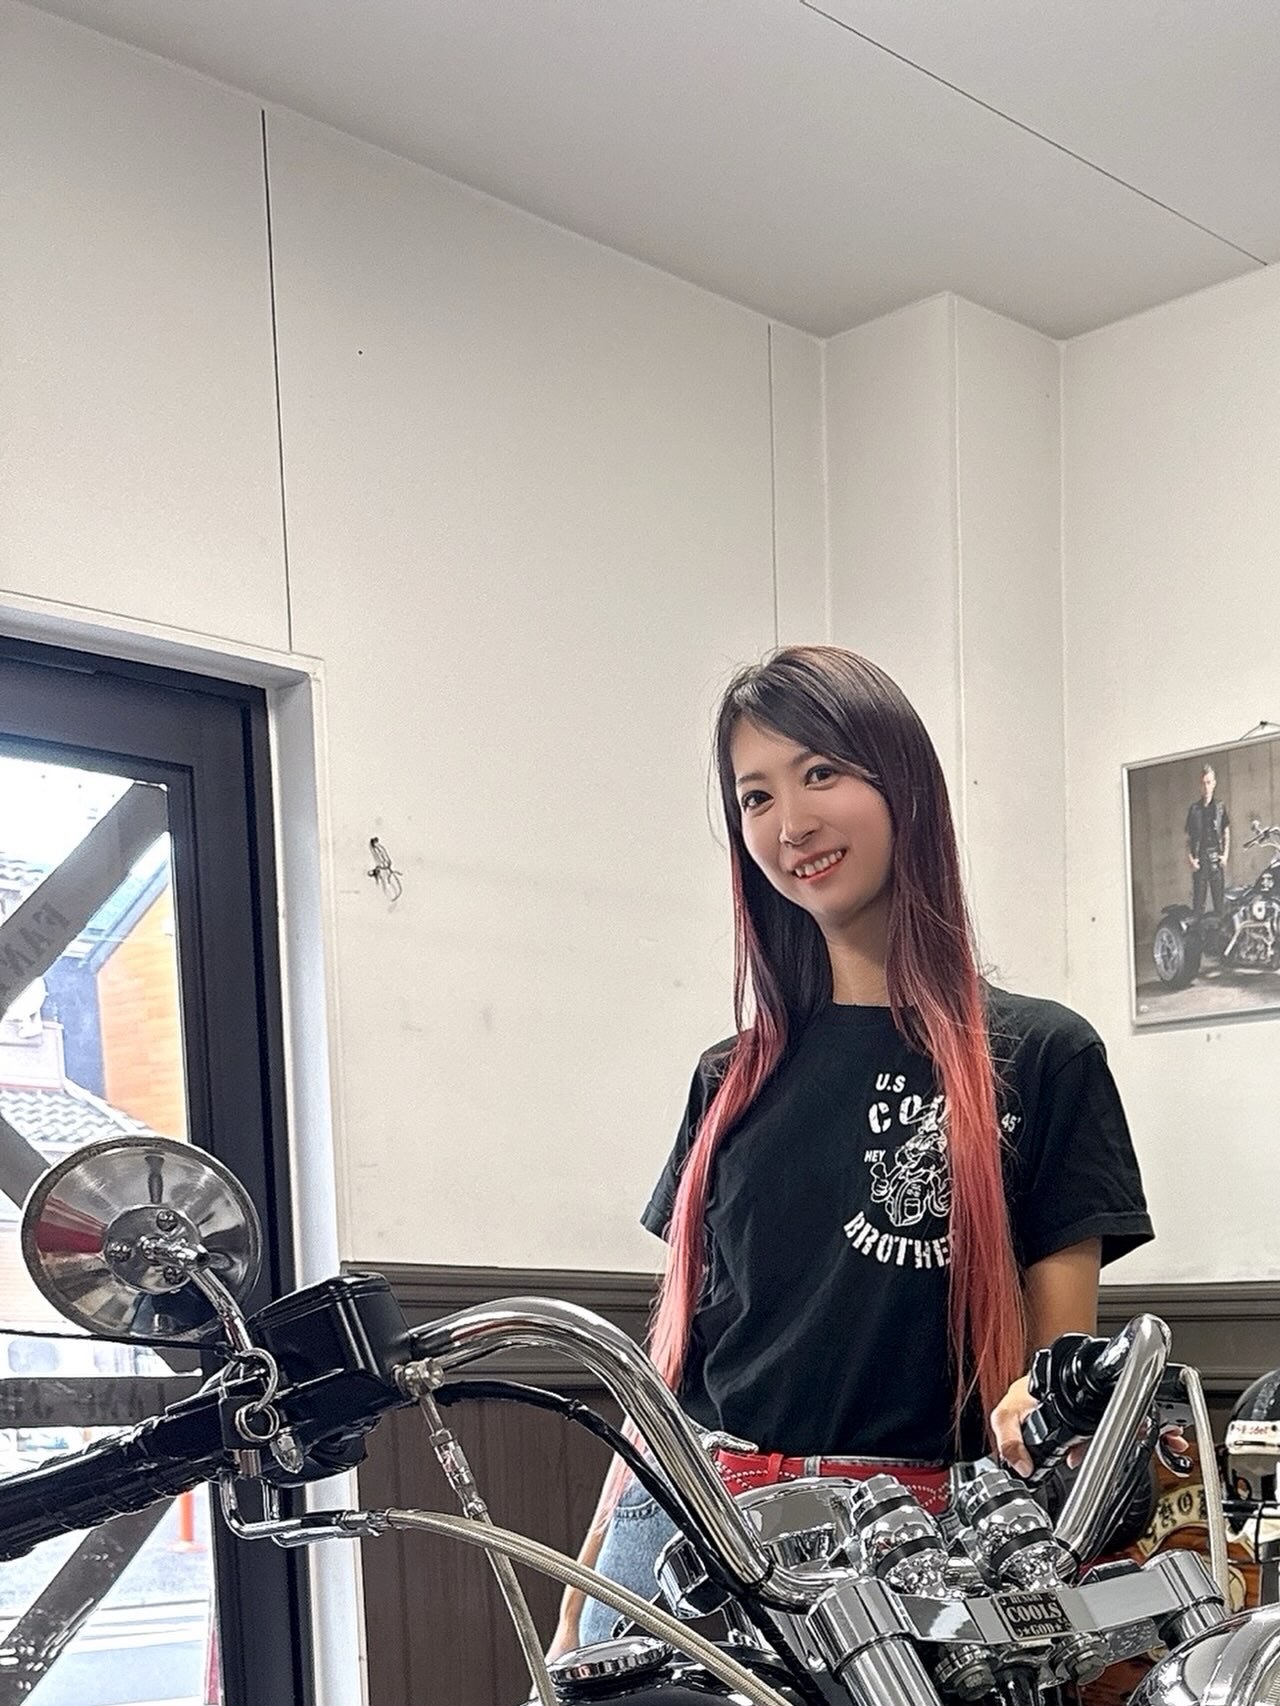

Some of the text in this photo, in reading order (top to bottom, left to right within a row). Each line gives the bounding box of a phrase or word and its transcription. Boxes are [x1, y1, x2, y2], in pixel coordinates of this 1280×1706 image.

[875, 1073, 906, 1093] U.S
[864, 1150, 887, 1163] HEY
[843, 1211, 951, 1269] BROTHE
[1006, 1602, 1063, 1623] COOLS
[1030, 1623, 1056, 1636] GOD
